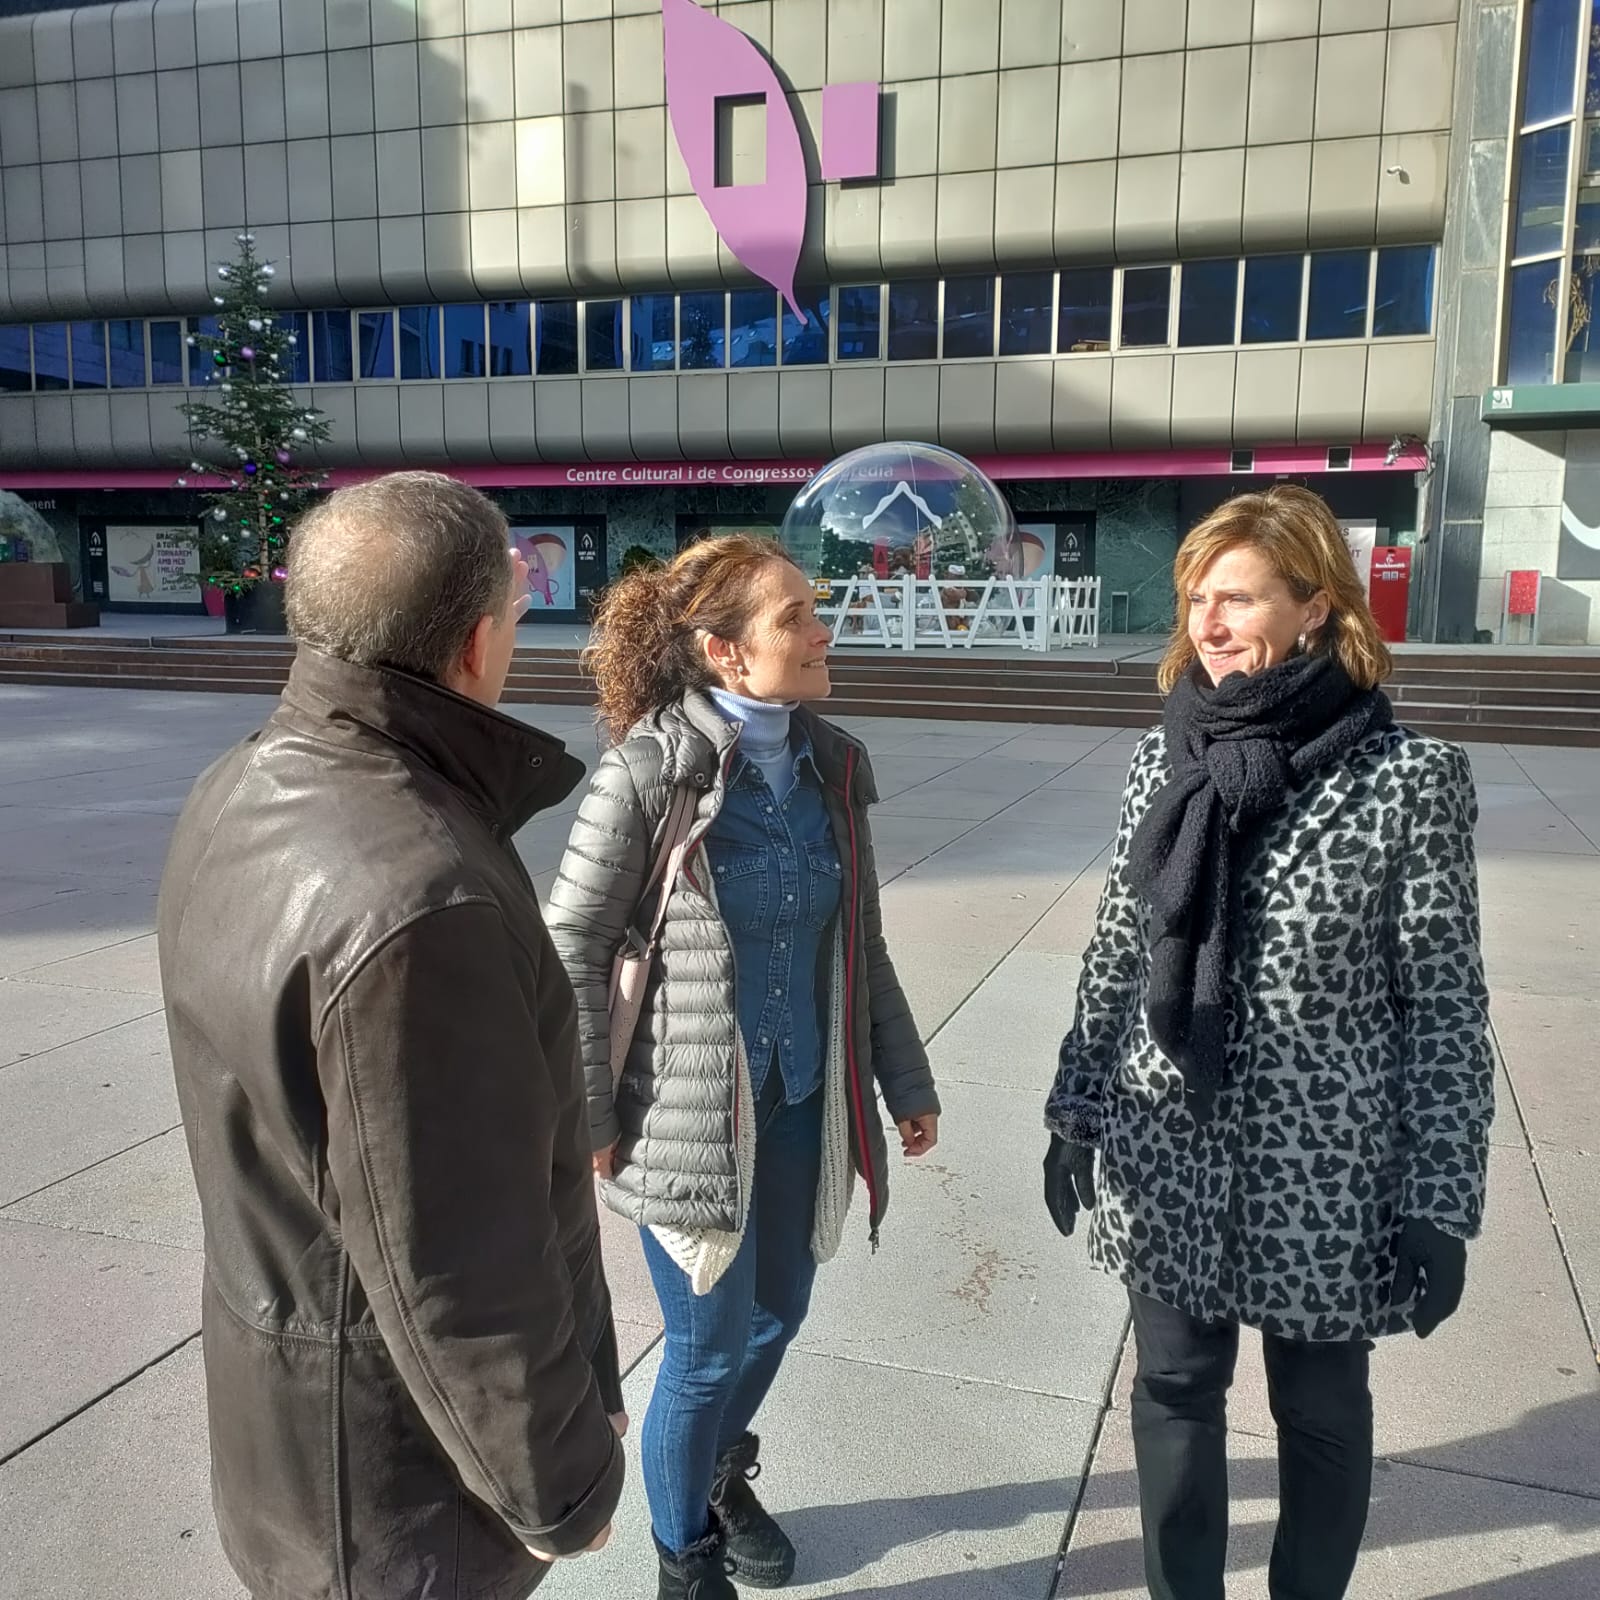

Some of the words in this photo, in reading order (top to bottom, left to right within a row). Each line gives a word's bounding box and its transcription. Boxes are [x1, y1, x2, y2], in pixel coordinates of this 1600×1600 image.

[566, 468, 617, 482] Centre
[622, 467, 683, 481] Cultural
[688, 467, 692, 480] i
[697, 467, 716, 480] de
[721, 465, 815, 482] Congressos
